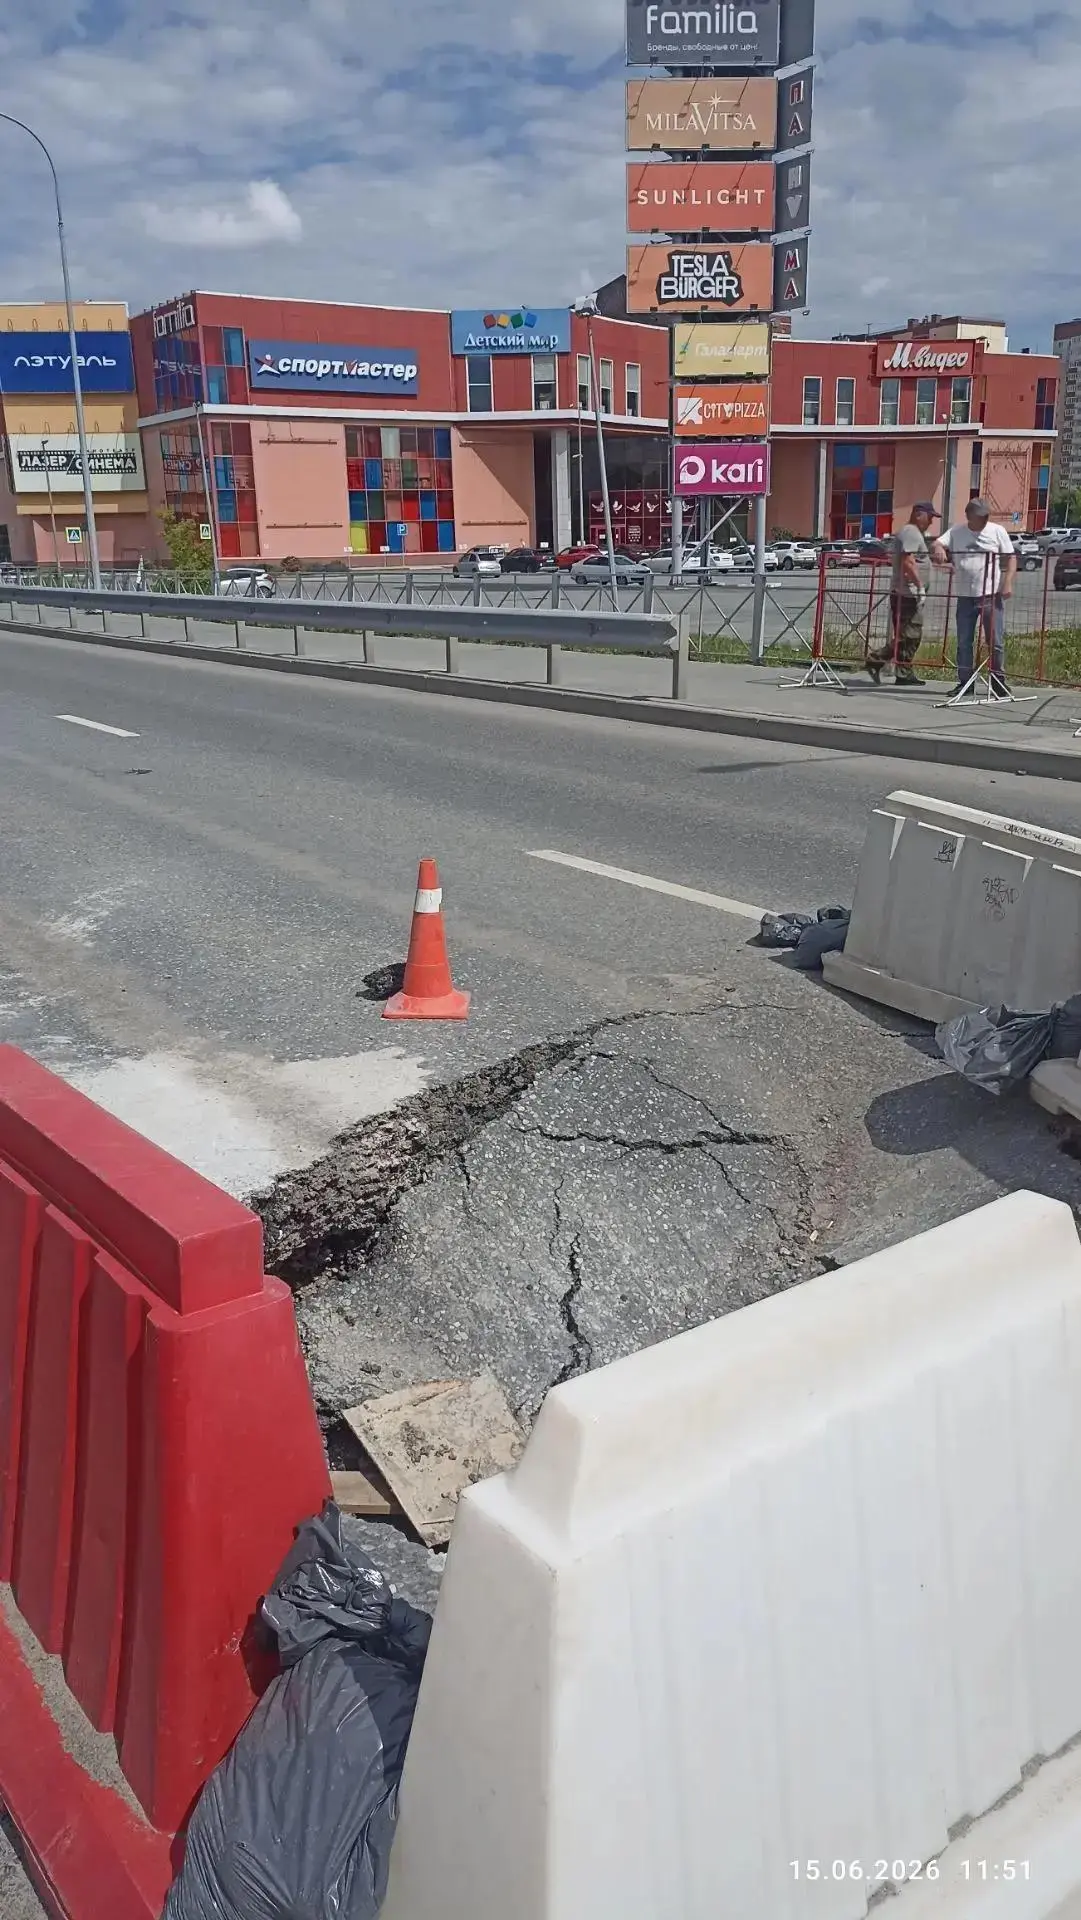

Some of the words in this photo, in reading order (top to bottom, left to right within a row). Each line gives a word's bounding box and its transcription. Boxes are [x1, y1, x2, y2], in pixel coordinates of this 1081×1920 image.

[646, 3, 758, 34] familia
[682, 43, 728, 51] свободные
[646, 102, 757, 135] MILAVITSA
[637, 189, 765, 205] SUNLIGHT
[671, 254, 729, 277] TESLA
[660, 276, 740, 299] BURGER
[153, 301, 195, 338] familia
[464, 333, 525, 347] Детский
[529, 334, 559, 349] мир
[278, 357, 418, 381] спортмастер
[20, 455, 67, 467] ЛАЗЕР
[711, 458, 764, 484] kari
